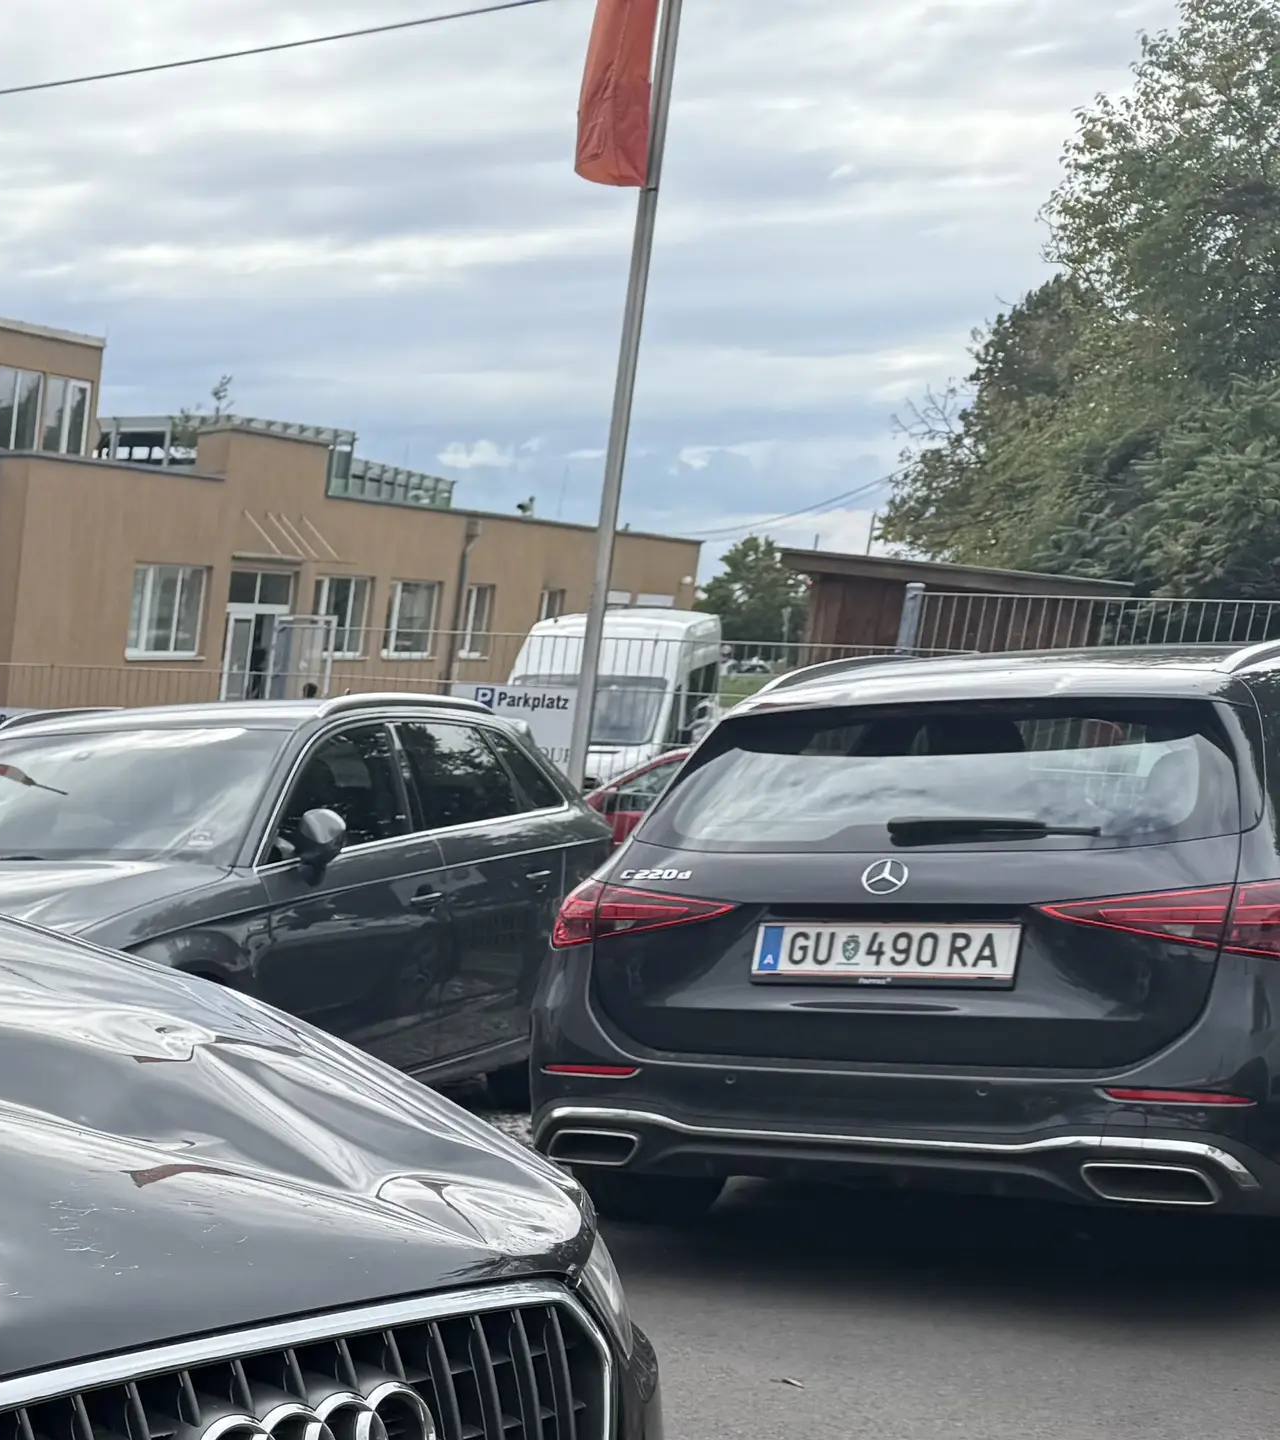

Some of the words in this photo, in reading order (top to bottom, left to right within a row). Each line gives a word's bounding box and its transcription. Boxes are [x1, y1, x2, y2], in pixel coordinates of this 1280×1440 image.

[497, 692, 569, 711] Parkplatz
[763, 954, 774, 965] A
[788, 932, 835, 966] GU
[866, 932, 939, 967] 490
[947, 933, 998, 968] RA
